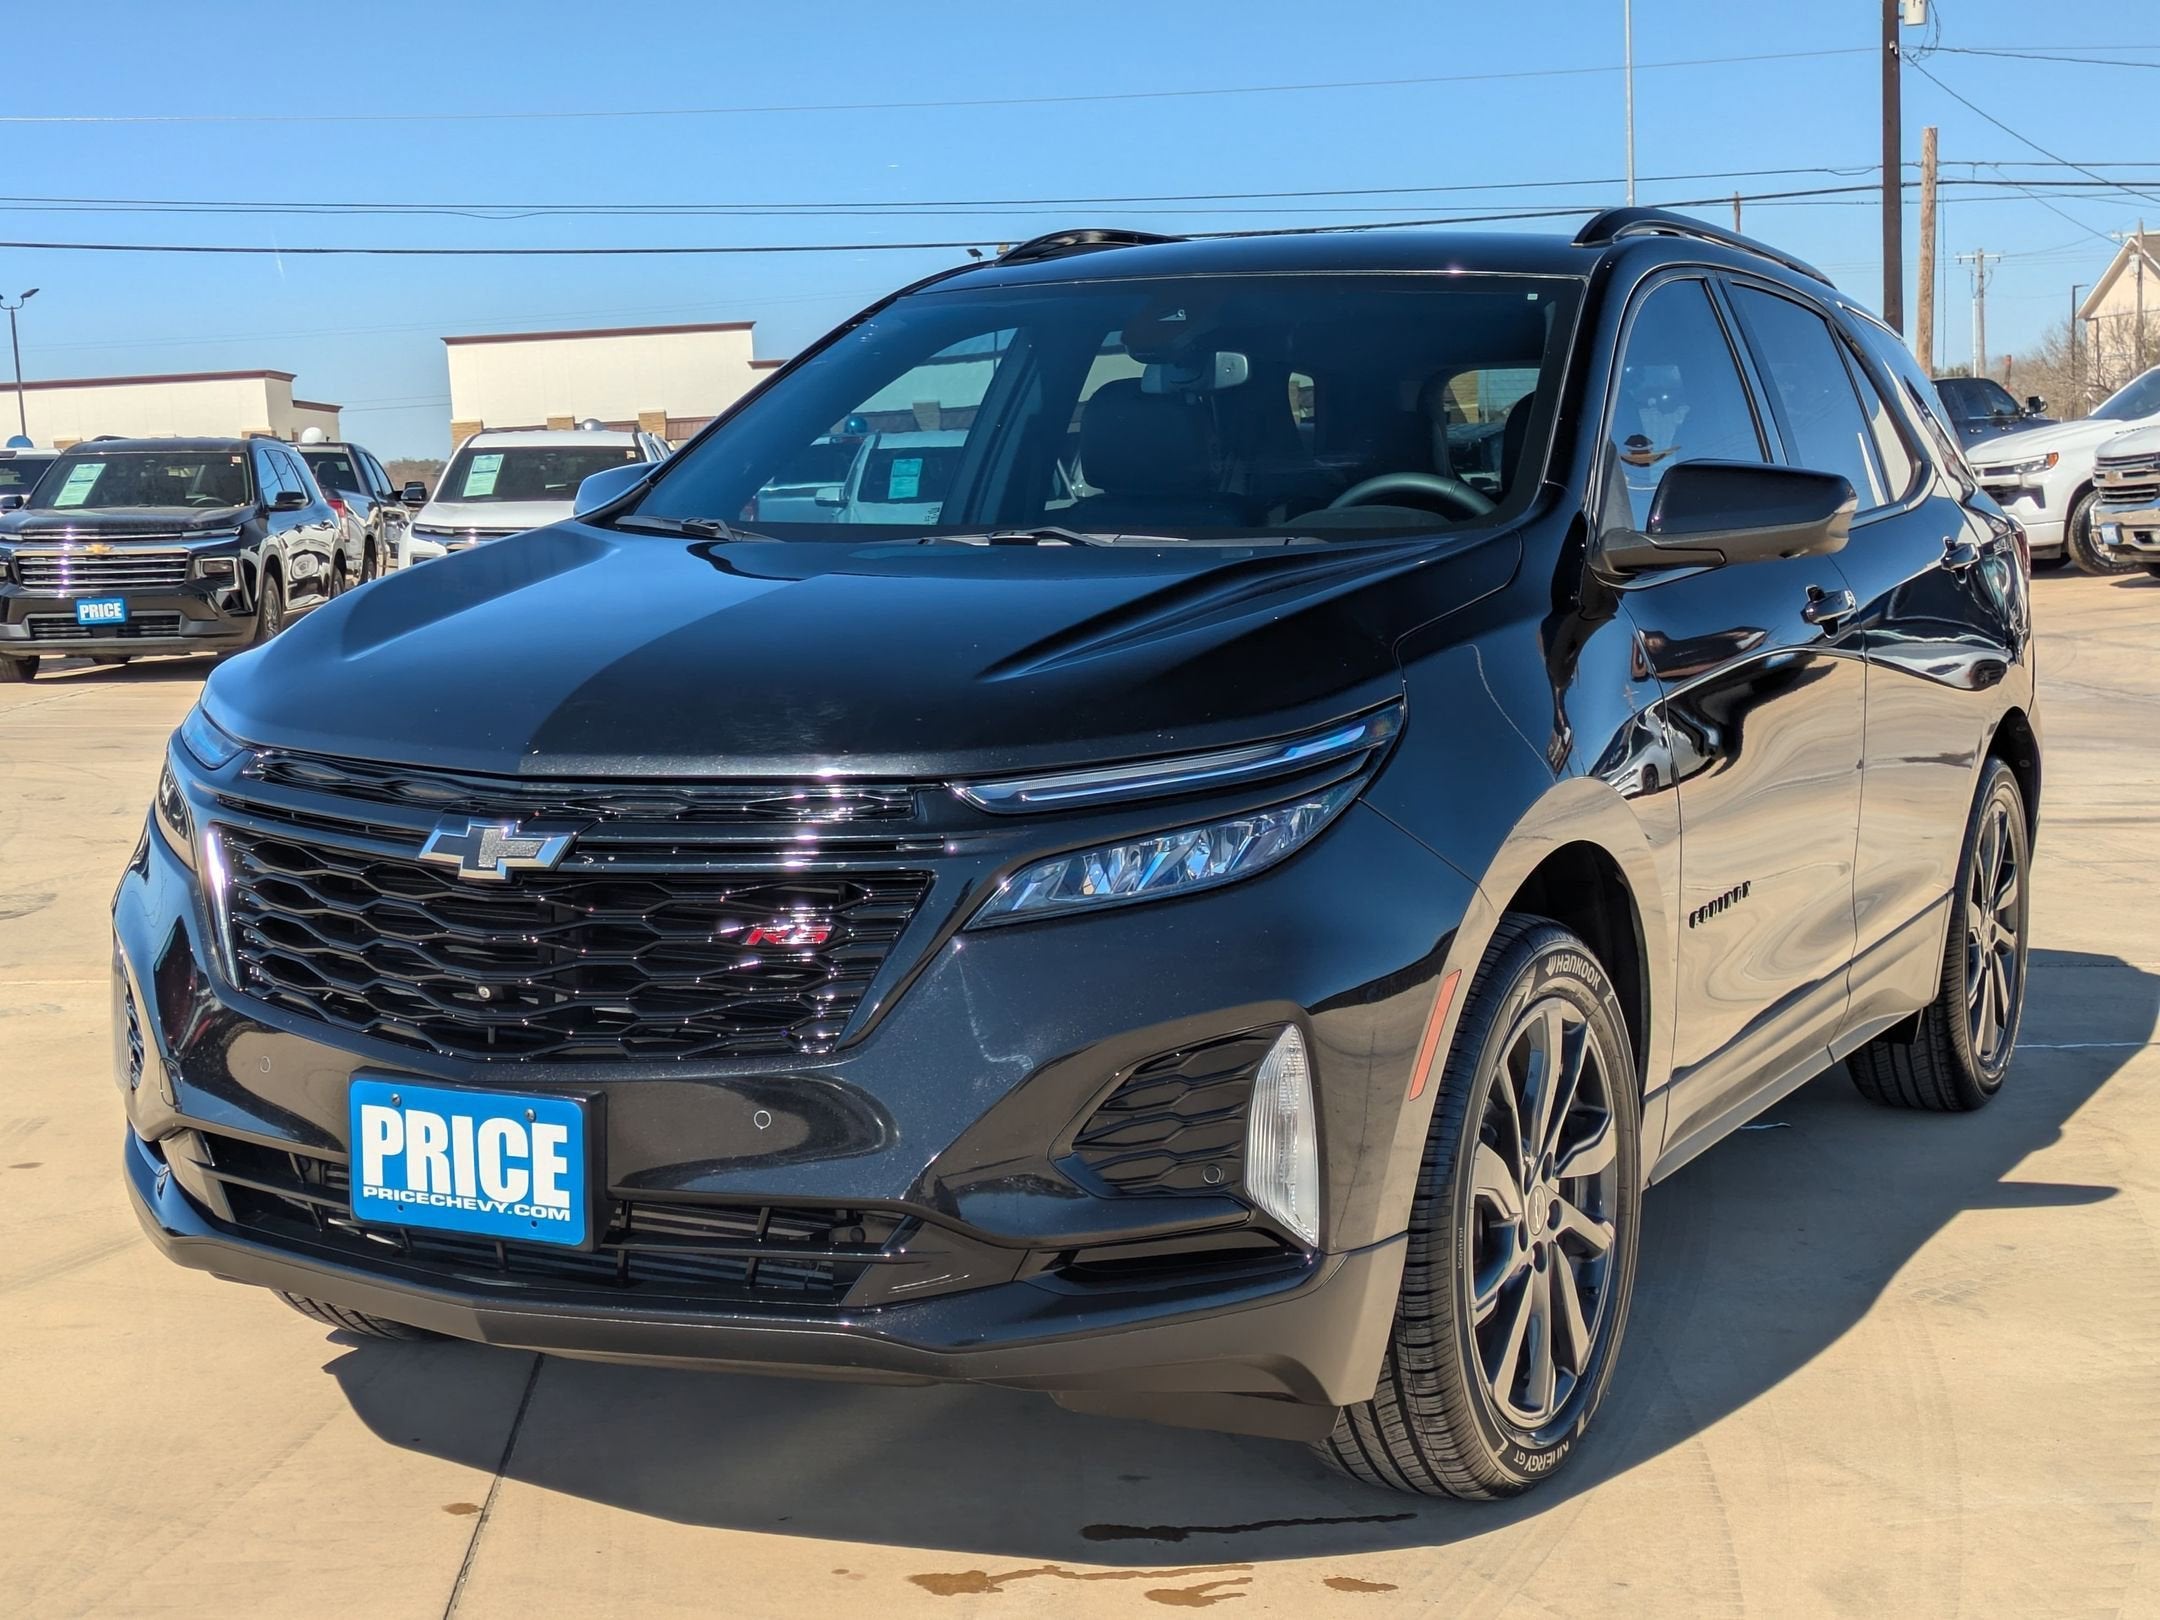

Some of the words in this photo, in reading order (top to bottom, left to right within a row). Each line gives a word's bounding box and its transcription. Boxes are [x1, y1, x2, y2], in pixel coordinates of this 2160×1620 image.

[79, 602, 123, 619] PRICE
[742, 924, 832, 945] RS
[361, 1104, 570, 1209] PRICE
[362, 1185, 571, 1222] PRICECHEVY.COM
[1513, 1449, 1527, 1466] GT
